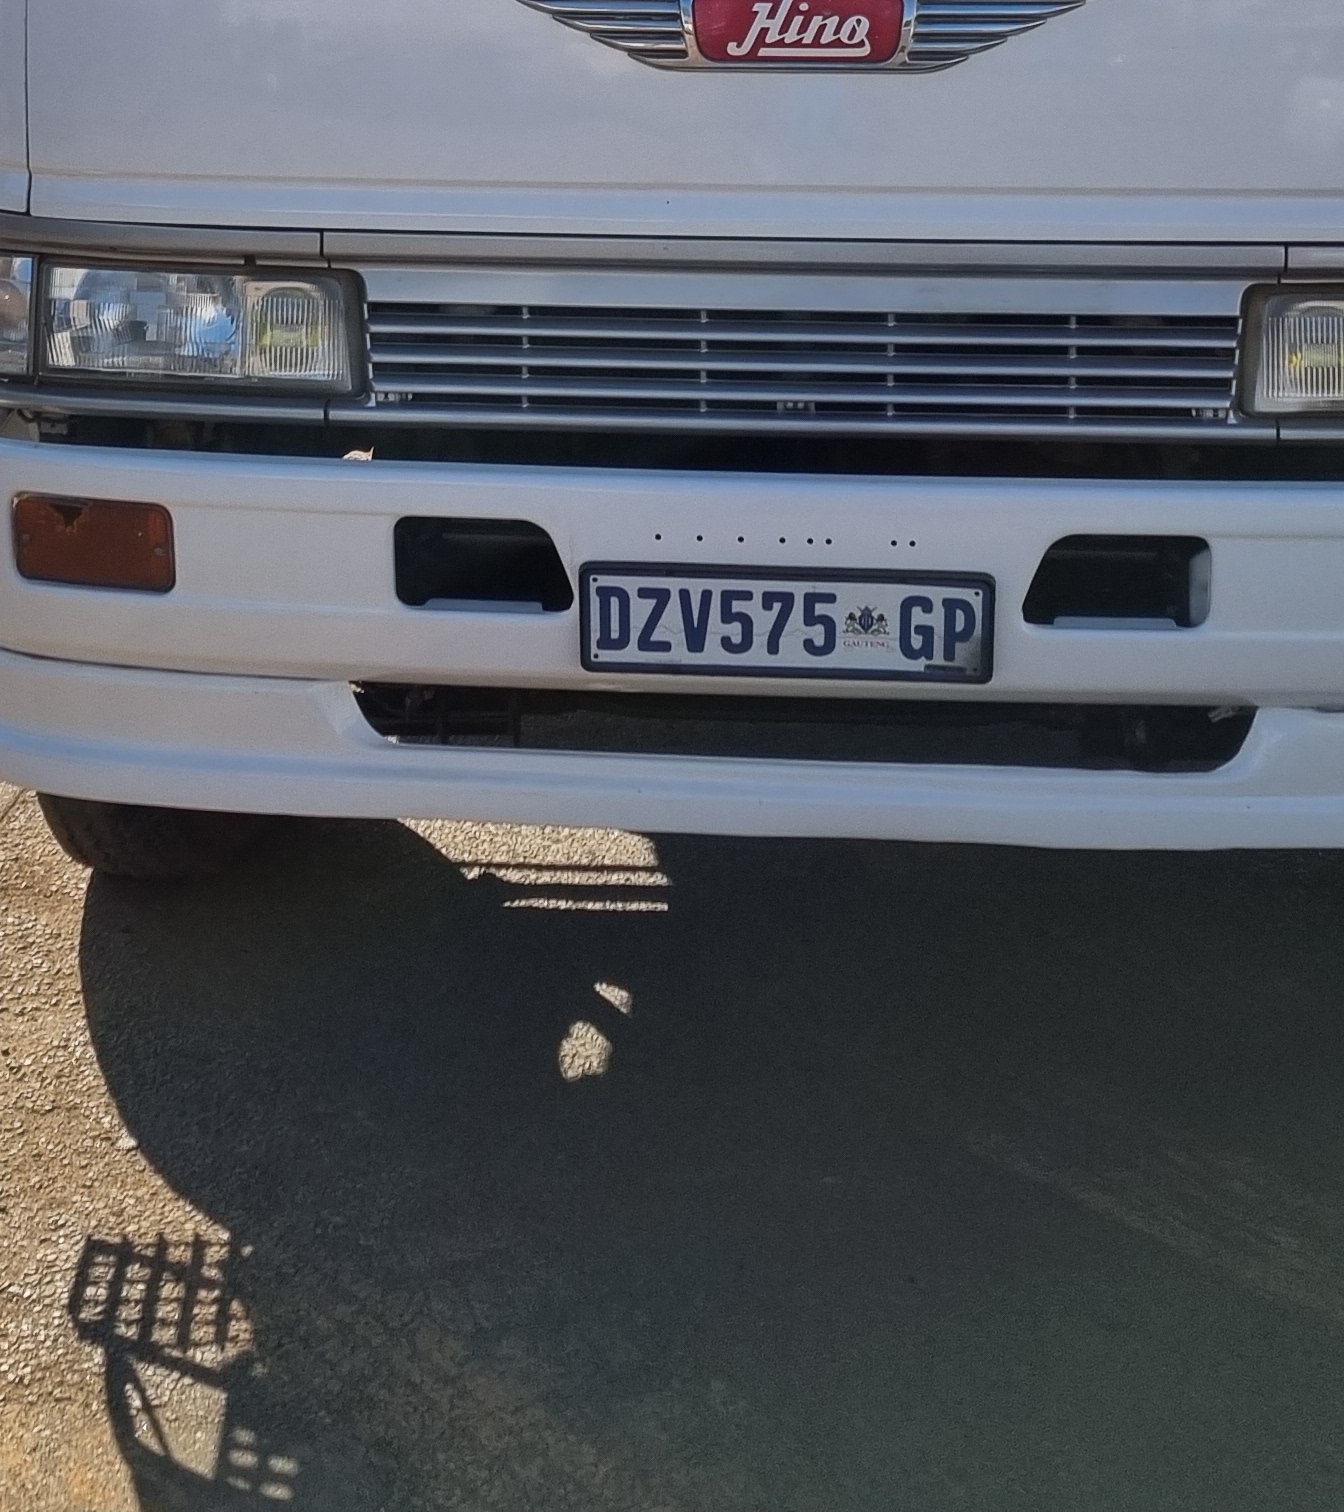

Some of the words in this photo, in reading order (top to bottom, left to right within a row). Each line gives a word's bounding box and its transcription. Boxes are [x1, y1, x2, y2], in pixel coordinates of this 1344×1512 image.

[596, 585, 836, 657] DZV575
[899, 595, 976, 663] GP
[842, 639, 890, 648] GAUTENG
